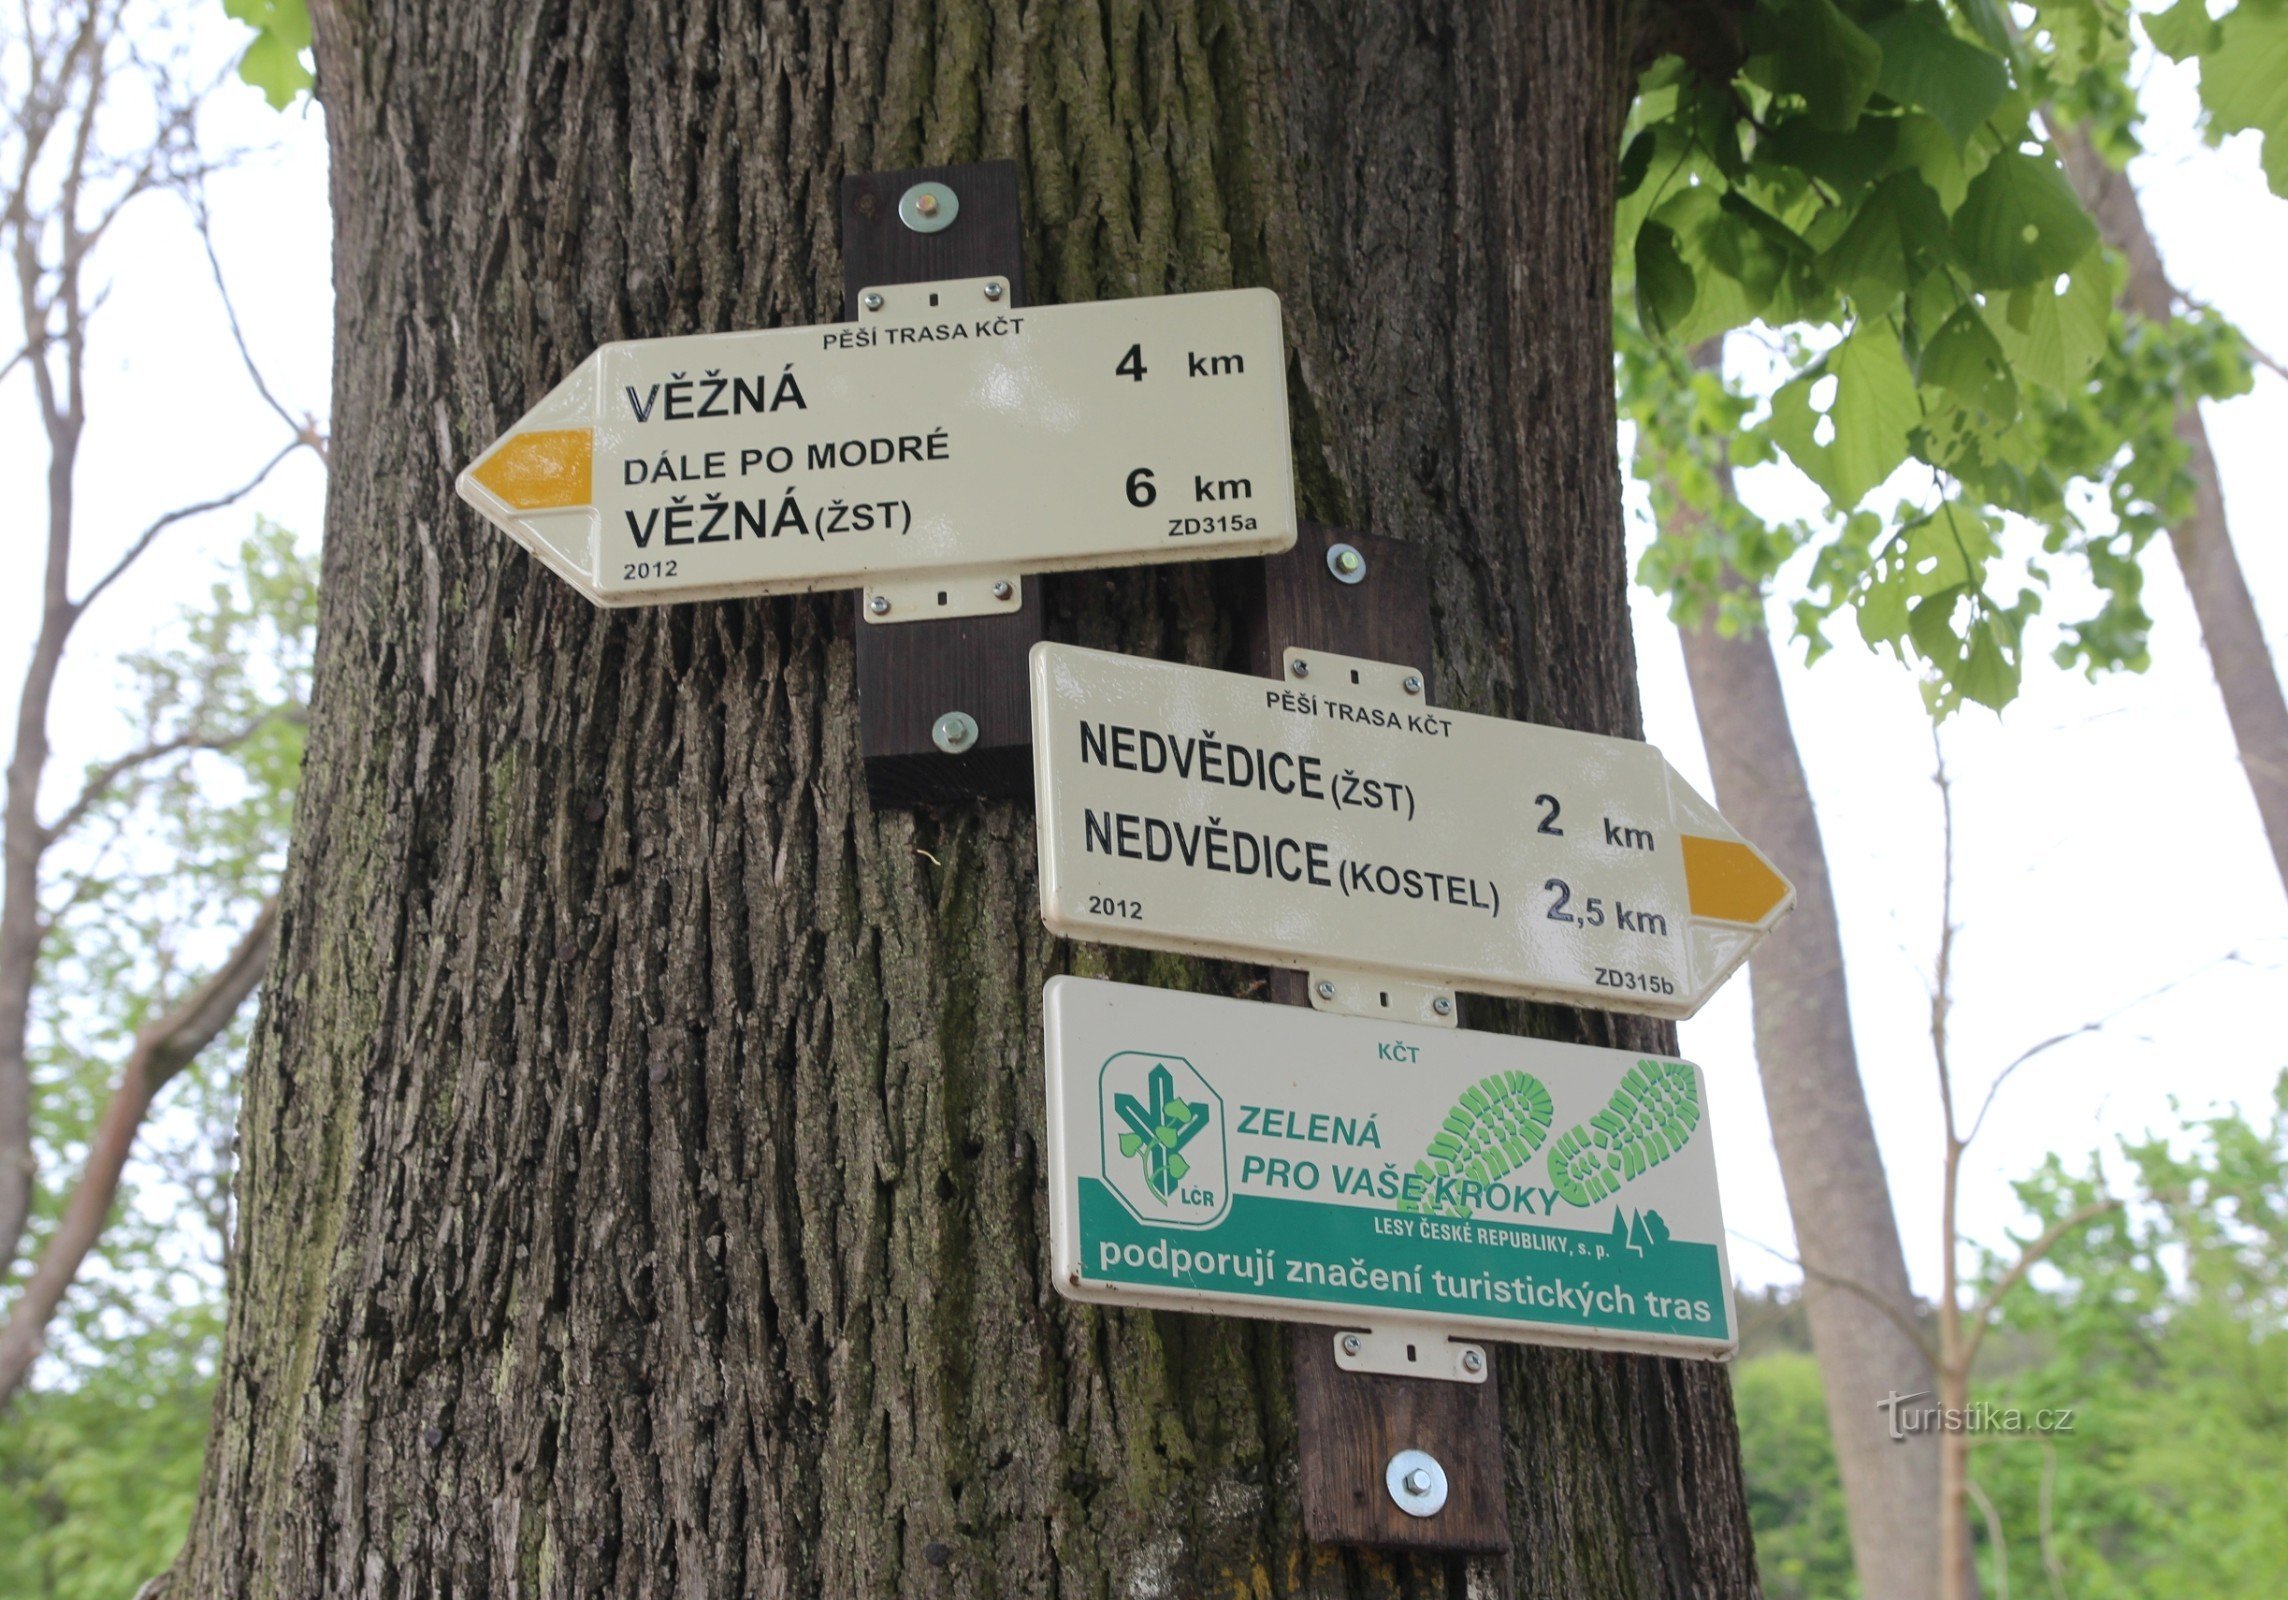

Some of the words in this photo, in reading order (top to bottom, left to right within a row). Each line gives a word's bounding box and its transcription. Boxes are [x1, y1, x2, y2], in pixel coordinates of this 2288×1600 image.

[822, 326, 878, 351] PĚŠÍ
[885, 322, 968, 347] TRASA
[975, 316, 1025, 338] KČT
[625, 362, 808, 424] VĚŽNÁ
[1115, 343, 1148, 383] 4
[1187, 351, 1245, 378] km
[624, 449, 727, 486] DÁLE
[740, 445, 794, 476] PO
[807, 426, 950, 471] MODRÉ
[624, 486, 809, 549] VĚŽNÁ
[1125, 466, 1158, 508] 6
[1194, 474, 1253, 503] km
[1167, 513, 1259, 537] ZD315a
[623, 559, 678, 581] 2012
[1265, 688, 1318, 717] PĚŠÍ
[1323, 700, 1402, 730] TRASA
[1407, 713, 1452, 738] KČT
[1079, 719, 1325, 801] NEDVĚDICE
[1534, 793, 1565, 837] 2
[1603, 816, 1656, 852] km
[1083, 807, 1333, 888] NEDVĚDICE
[1544, 877, 1606, 929] 2,5
[1615, 901, 1668, 936] km
[1088, 895, 1144, 921] 2012
[1594, 966, 1675, 996] ZD315b
[1377, 1039, 1420, 1065] KČT
[1236, 1104, 1383, 1150] ZELENÁ
[1180, 1184, 1215, 1208] LČR
[1240, 1154, 1321, 1191] PRO
[1331, 1161, 1424, 1202] VAŠE
[1434, 1176, 1561, 1217] KROKY
[1373, 1216, 1415, 1238] LESY
[1419, 1220, 1473, 1244] ČESKÉ
[1477, 1227, 1574, 1257] REPUBLIKY,
[1099, 1237, 1276, 1287] podporují
[1285, 1256, 1423, 1295] značení
[1431, 1267, 1636, 1318] turistických
[1644, 1289, 1713, 1323] tras
